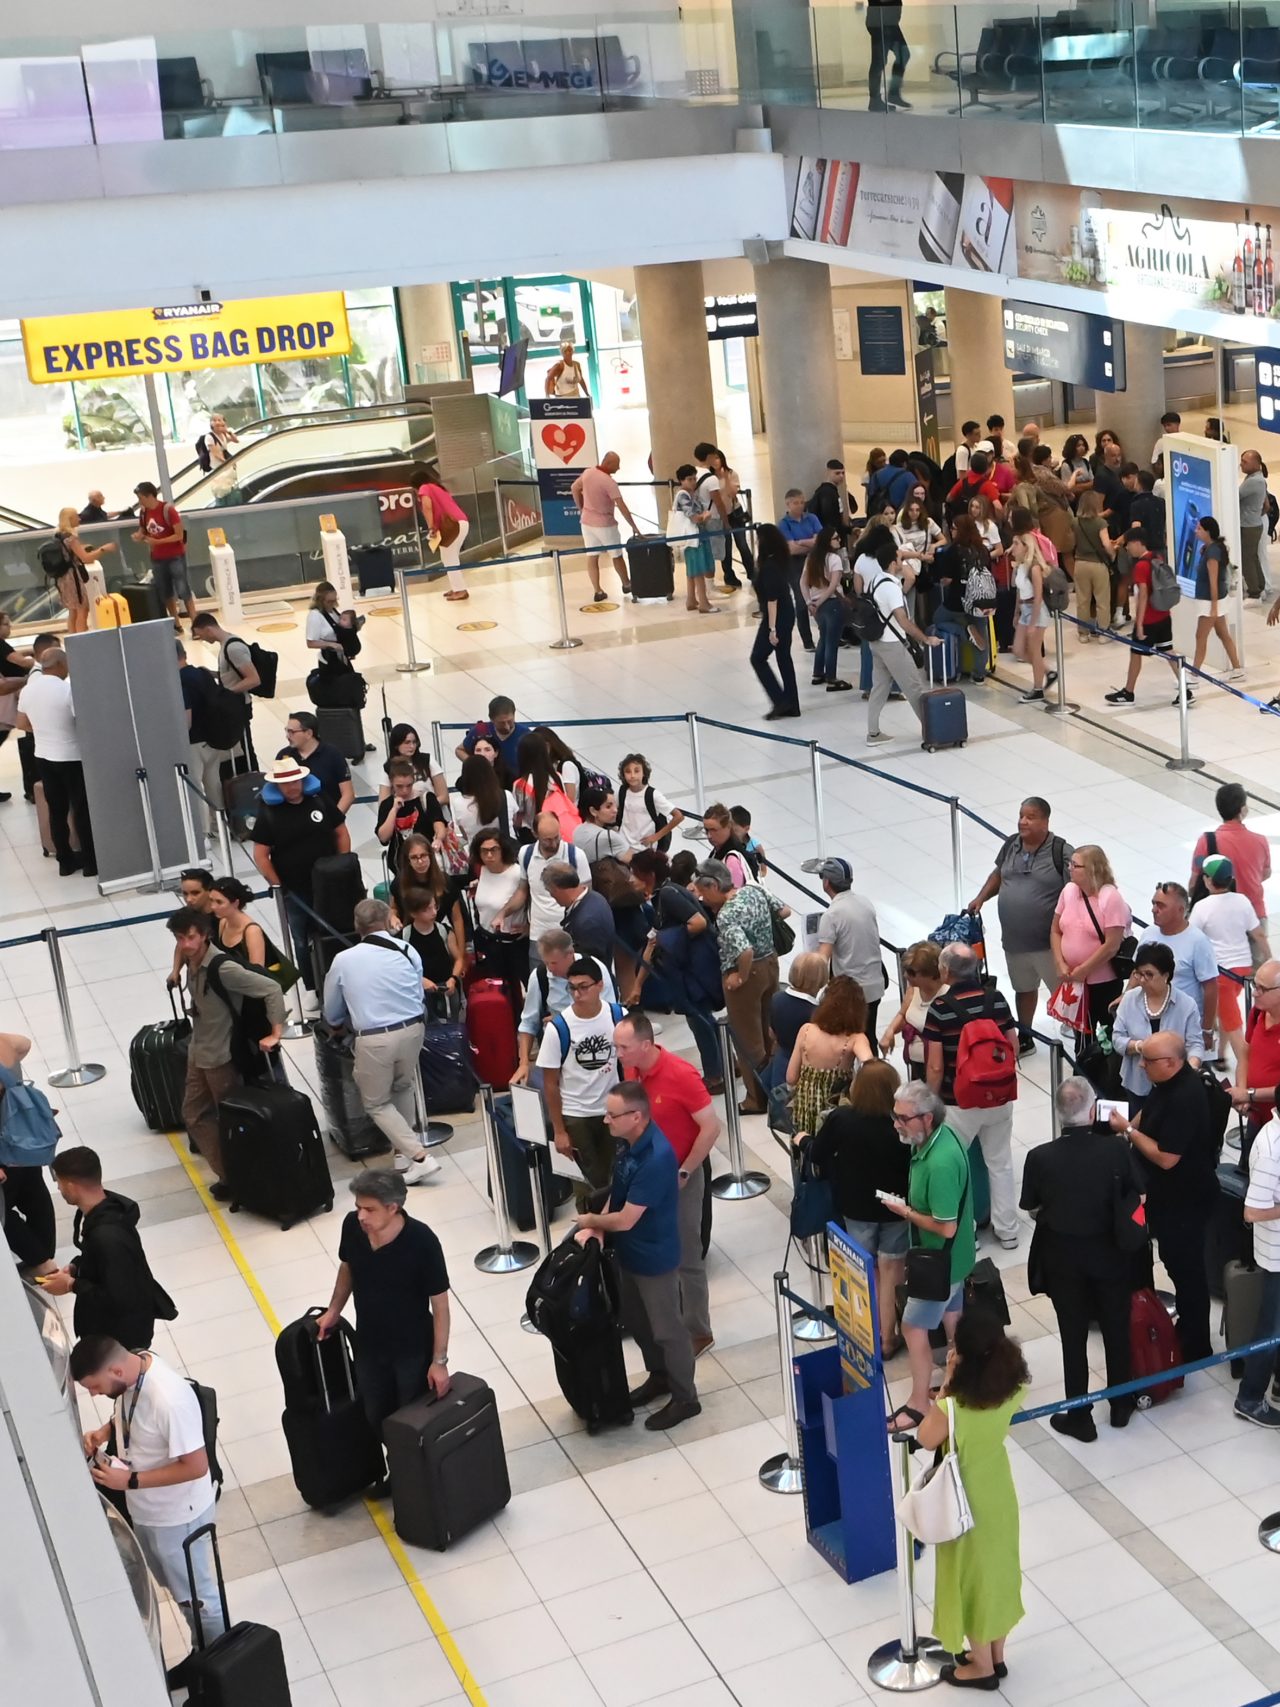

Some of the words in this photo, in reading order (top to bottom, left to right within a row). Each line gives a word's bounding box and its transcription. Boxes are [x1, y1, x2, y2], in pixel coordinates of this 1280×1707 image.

[1126, 244, 1211, 279] AGRICOLA
[163, 304, 220, 318] RYANAIR
[43, 334, 183, 374] EXPRESS
[190, 328, 250, 360] BAG
[256, 320, 335, 354] DROP
[1173, 457, 1189, 477] glo
[833, 1234, 865, 1269] RYANAIR
